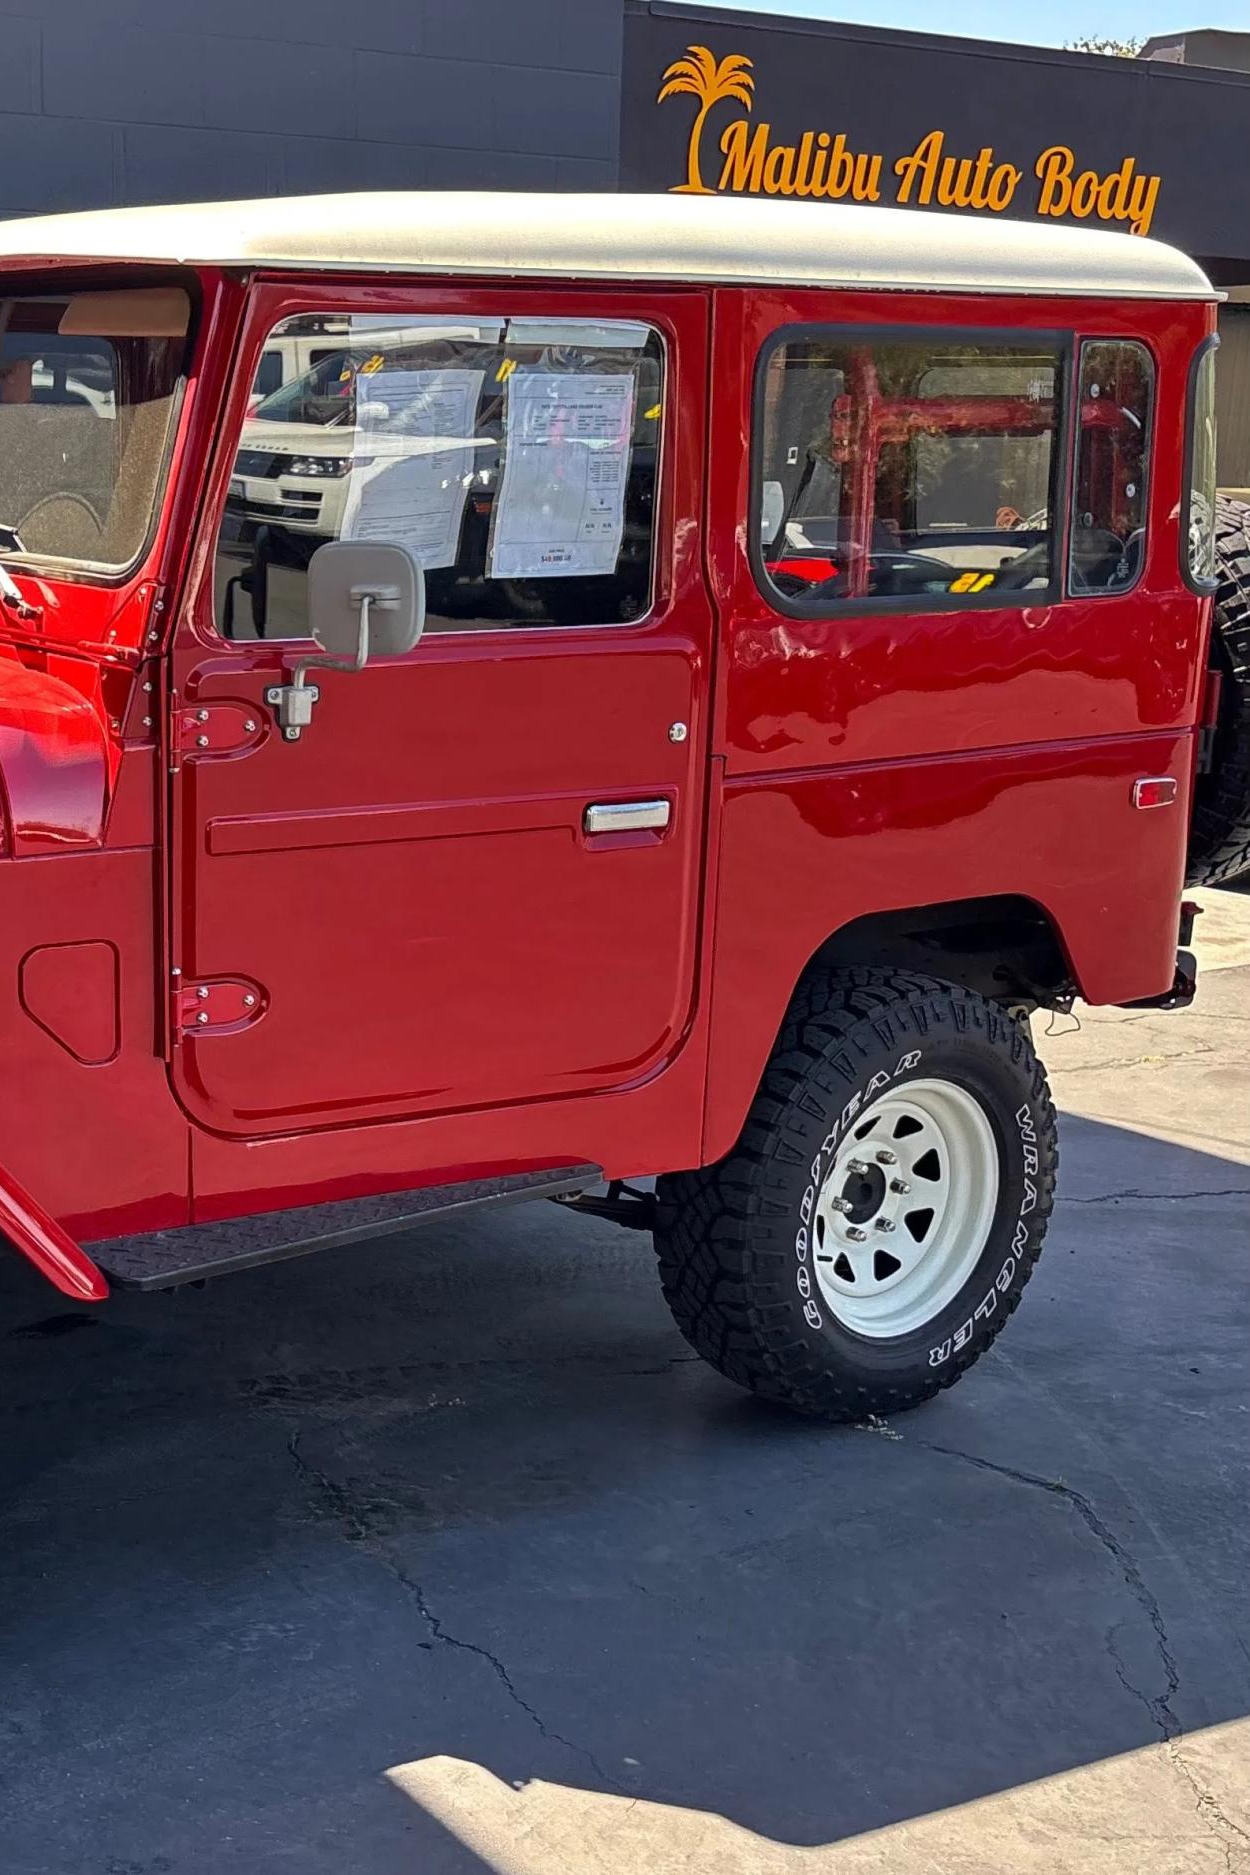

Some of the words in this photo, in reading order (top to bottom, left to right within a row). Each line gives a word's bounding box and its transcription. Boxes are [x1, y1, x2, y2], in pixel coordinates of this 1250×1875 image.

[719, 120, 883, 201] Malibu
[894, 130, 1023, 211] Auto
[1035, 146, 1161, 236] Body
[795, 1050, 921, 1330] GOODYEAR
[928, 1103, 1037, 1367] WRANGLER
